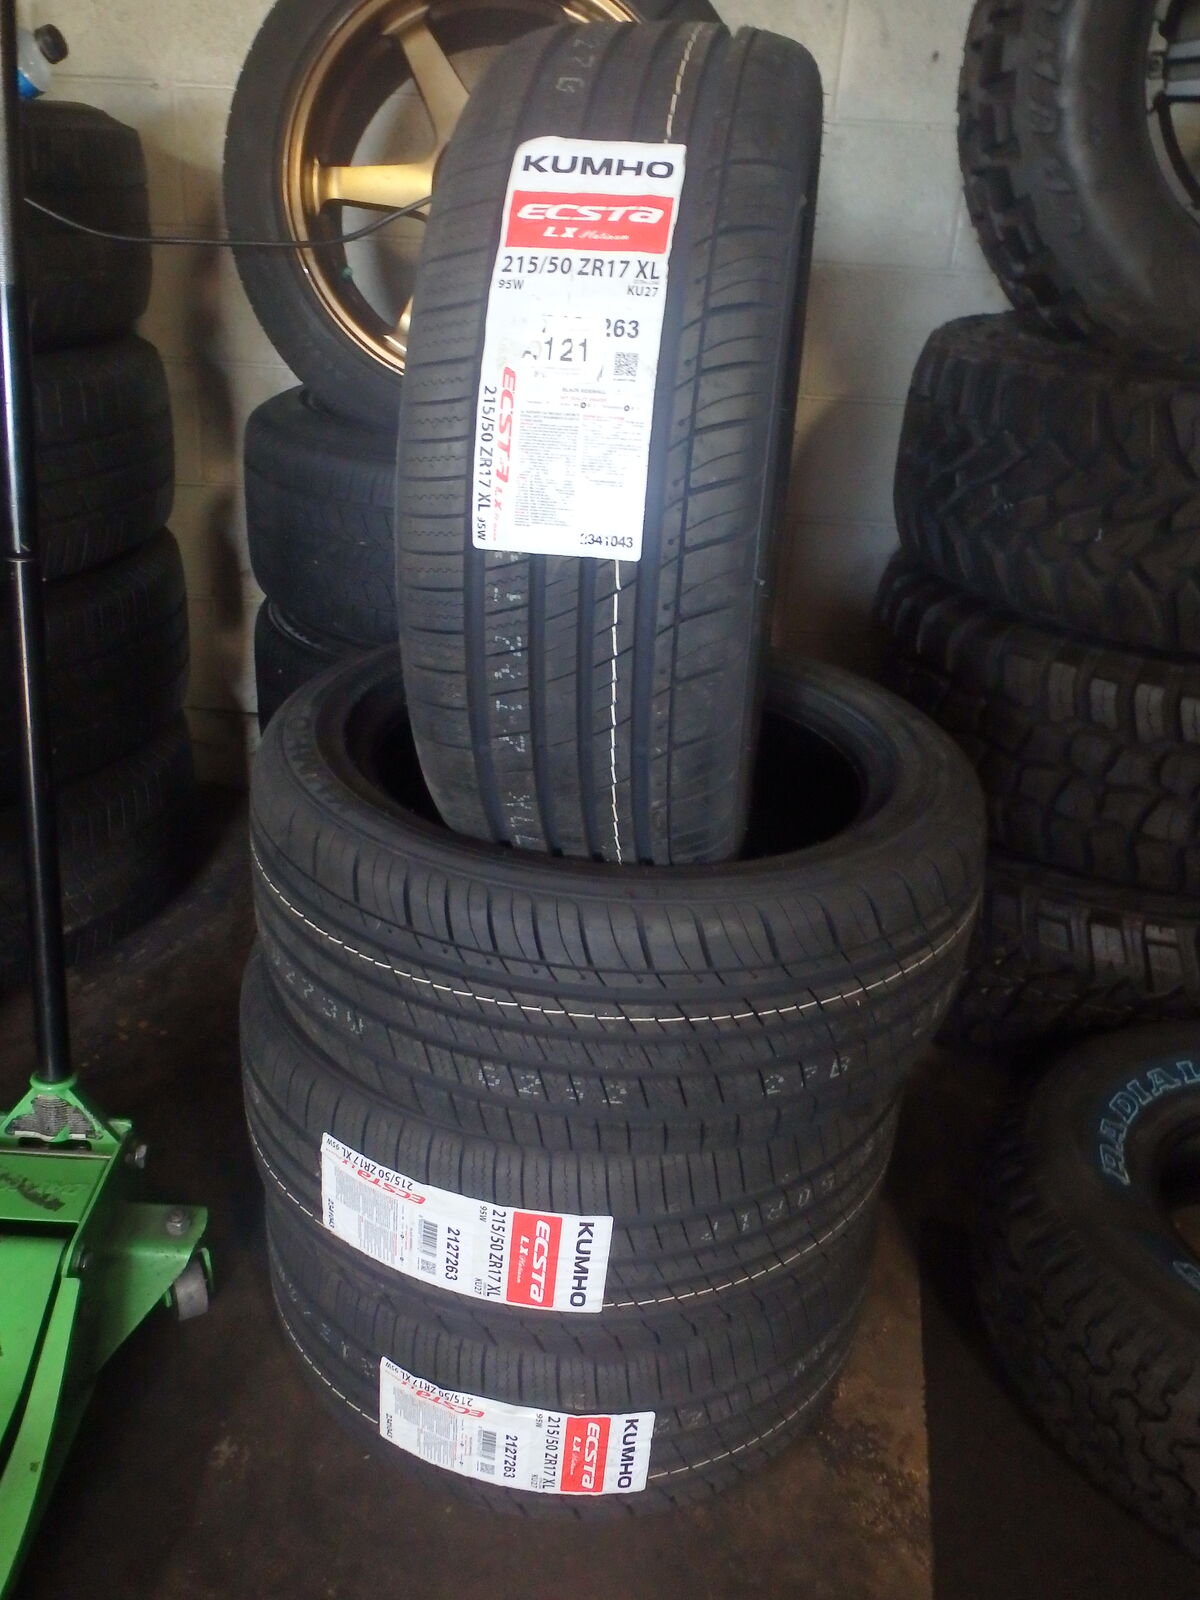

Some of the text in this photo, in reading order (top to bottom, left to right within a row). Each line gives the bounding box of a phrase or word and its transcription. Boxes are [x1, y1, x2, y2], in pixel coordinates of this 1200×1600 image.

[522, 155, 675, 179] KUMHO
[543, 226, 580, 239] LX
[501, 255, 660, 280] 215/50 ZR17 XL
[498, 279, 524, 290] 95W
[626, 285, 660, 297] KU27
[480, 386, 497, 443] 215/50
[478, 448, 494, 488] ZR17
[477, 493, 491, 512] XL
[341, 1147, 353, 1160] XL
[353, 1153, 377, 1176] ZR17
[379, 1168, 414, 1191] 215/50
[479, 1205, 488, 1223] 95W
[445, 1227, 461, 1281] 2127263
[486, 1209, 507, 1297] 215/50 ZR17 XL
[520, 1235, 530, 1256] LX
[570, 1222, 595, 1307] KUMHO
[474, 1278, 483, 1295] KU27
[400, 1371, 411, 1383] XL
[412, 1379, 437, 1395] ZR17
[535, 1413, 544, 1428] 95W
[542, 1416, 561, 1489] 215/50 ZR17 XL
[572, 1436, 582, 1453] LX
[617, 1418, 639, 1489] KUMHO
[503, 1434, 518, 1479] 2127263
